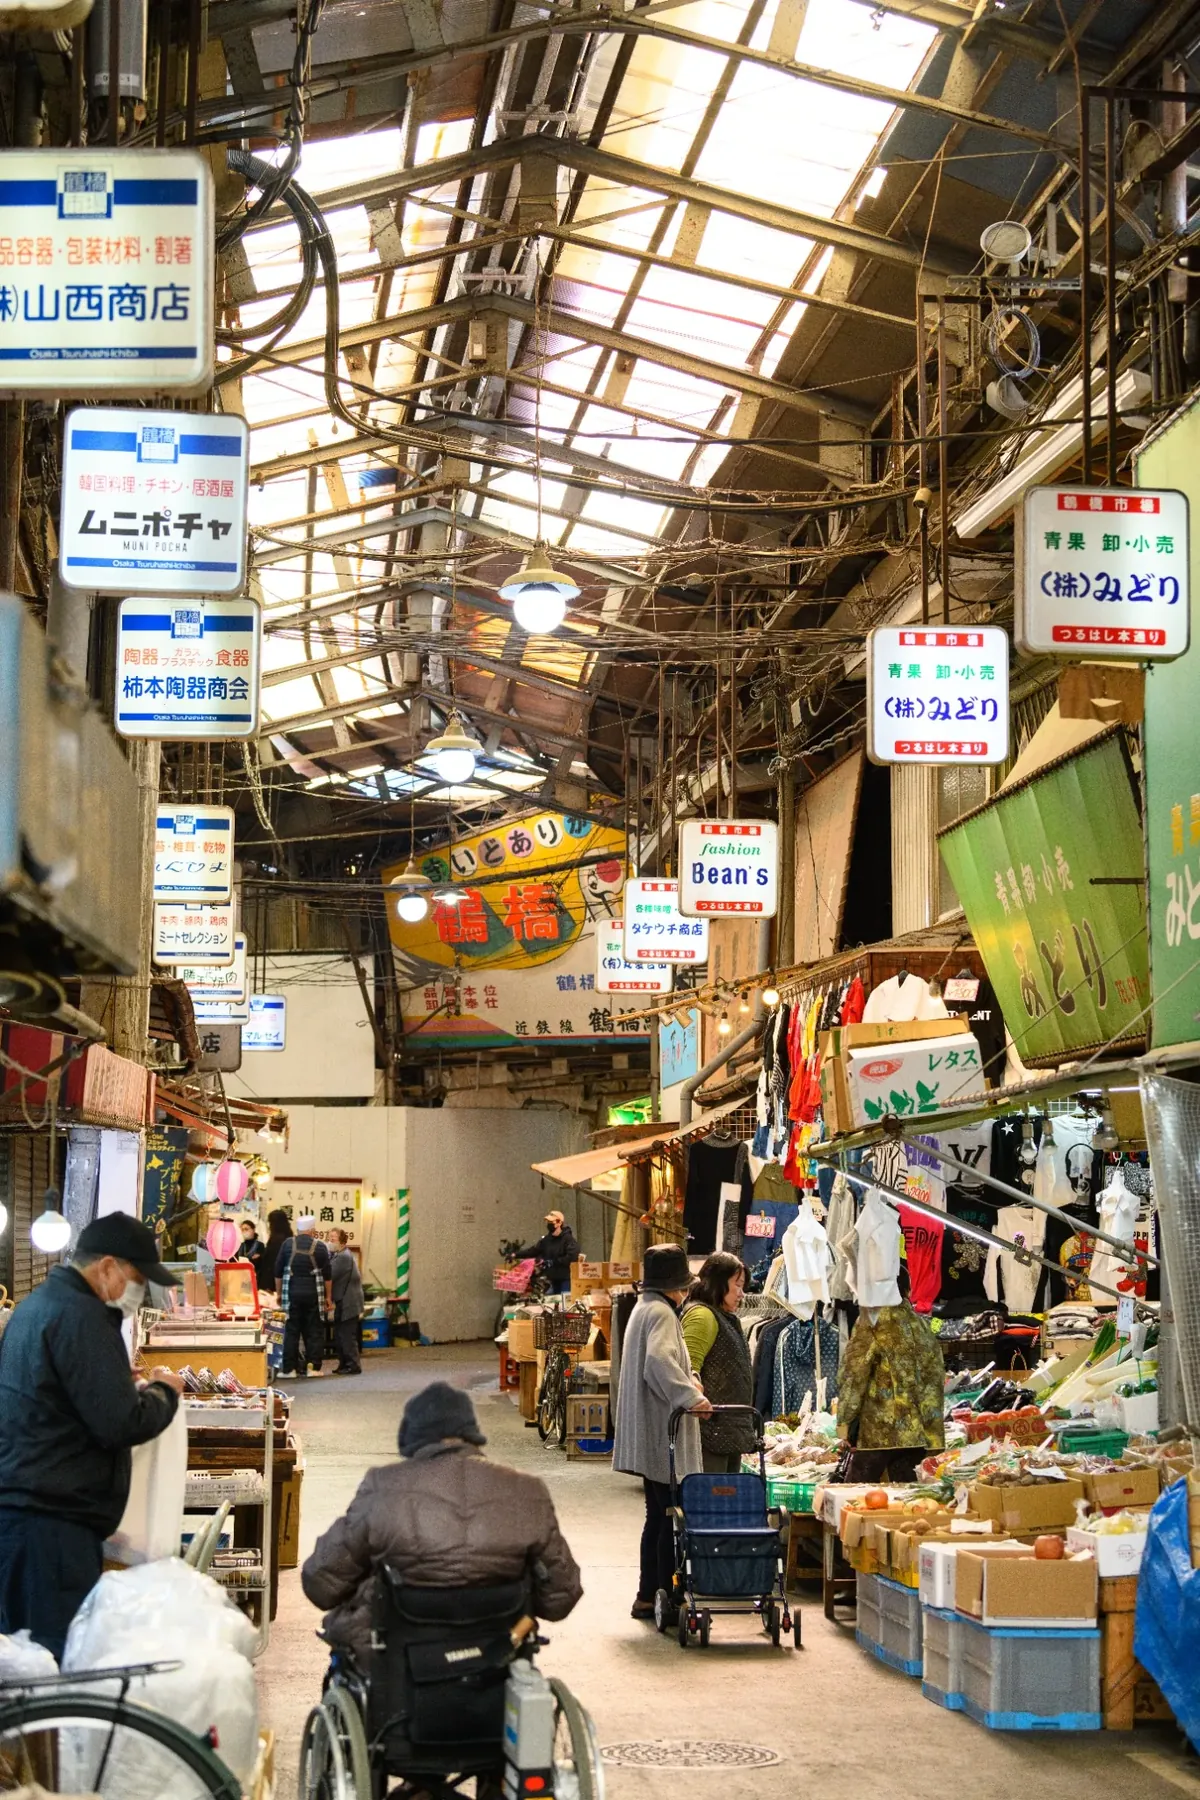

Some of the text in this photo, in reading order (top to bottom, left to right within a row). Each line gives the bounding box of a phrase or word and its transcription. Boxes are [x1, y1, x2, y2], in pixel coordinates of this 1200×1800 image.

[78, 474, 234, 498] 韓国料理・チキン・居酒屋
[78, 509, 232, 540] ムニポチャ
[123, 541, 188, 553] MUNI POCHA
[1044, 531, 1174, 554] 青果 卸・小売
[1041, 571, 1180, 605] (株)みどり
[1060, 628, 1161, 644] つるはし本通り
[124, 648, 158, 666] 陶器
[174, 647, 201, 657] ガラス
[215, 649, 249, 667] 食器
[161, 657, 214, 667] プラスチック
[888, 663, 995, 681] 青果 卸・小売
[123, 675, 249, 700] 柿本陶器商会
[884, 696, 999, 722] (株)みどり
[901, 743, 983, 753] つるはし本通り
[699, 842, 762, 857] fashion
[692, 861, 769, 886] Bean's
[700, 902, 760, 911] つるはし本通り
[160, 930, 228, 945] ミートセレクション
[631, 923, 703, 936] タケウチ商店
[1012, 917, 1108, 1021] みどり
[515, 1019, 575, 1035] 近鉄線
[928, 1048, 979, 1072] レタス
